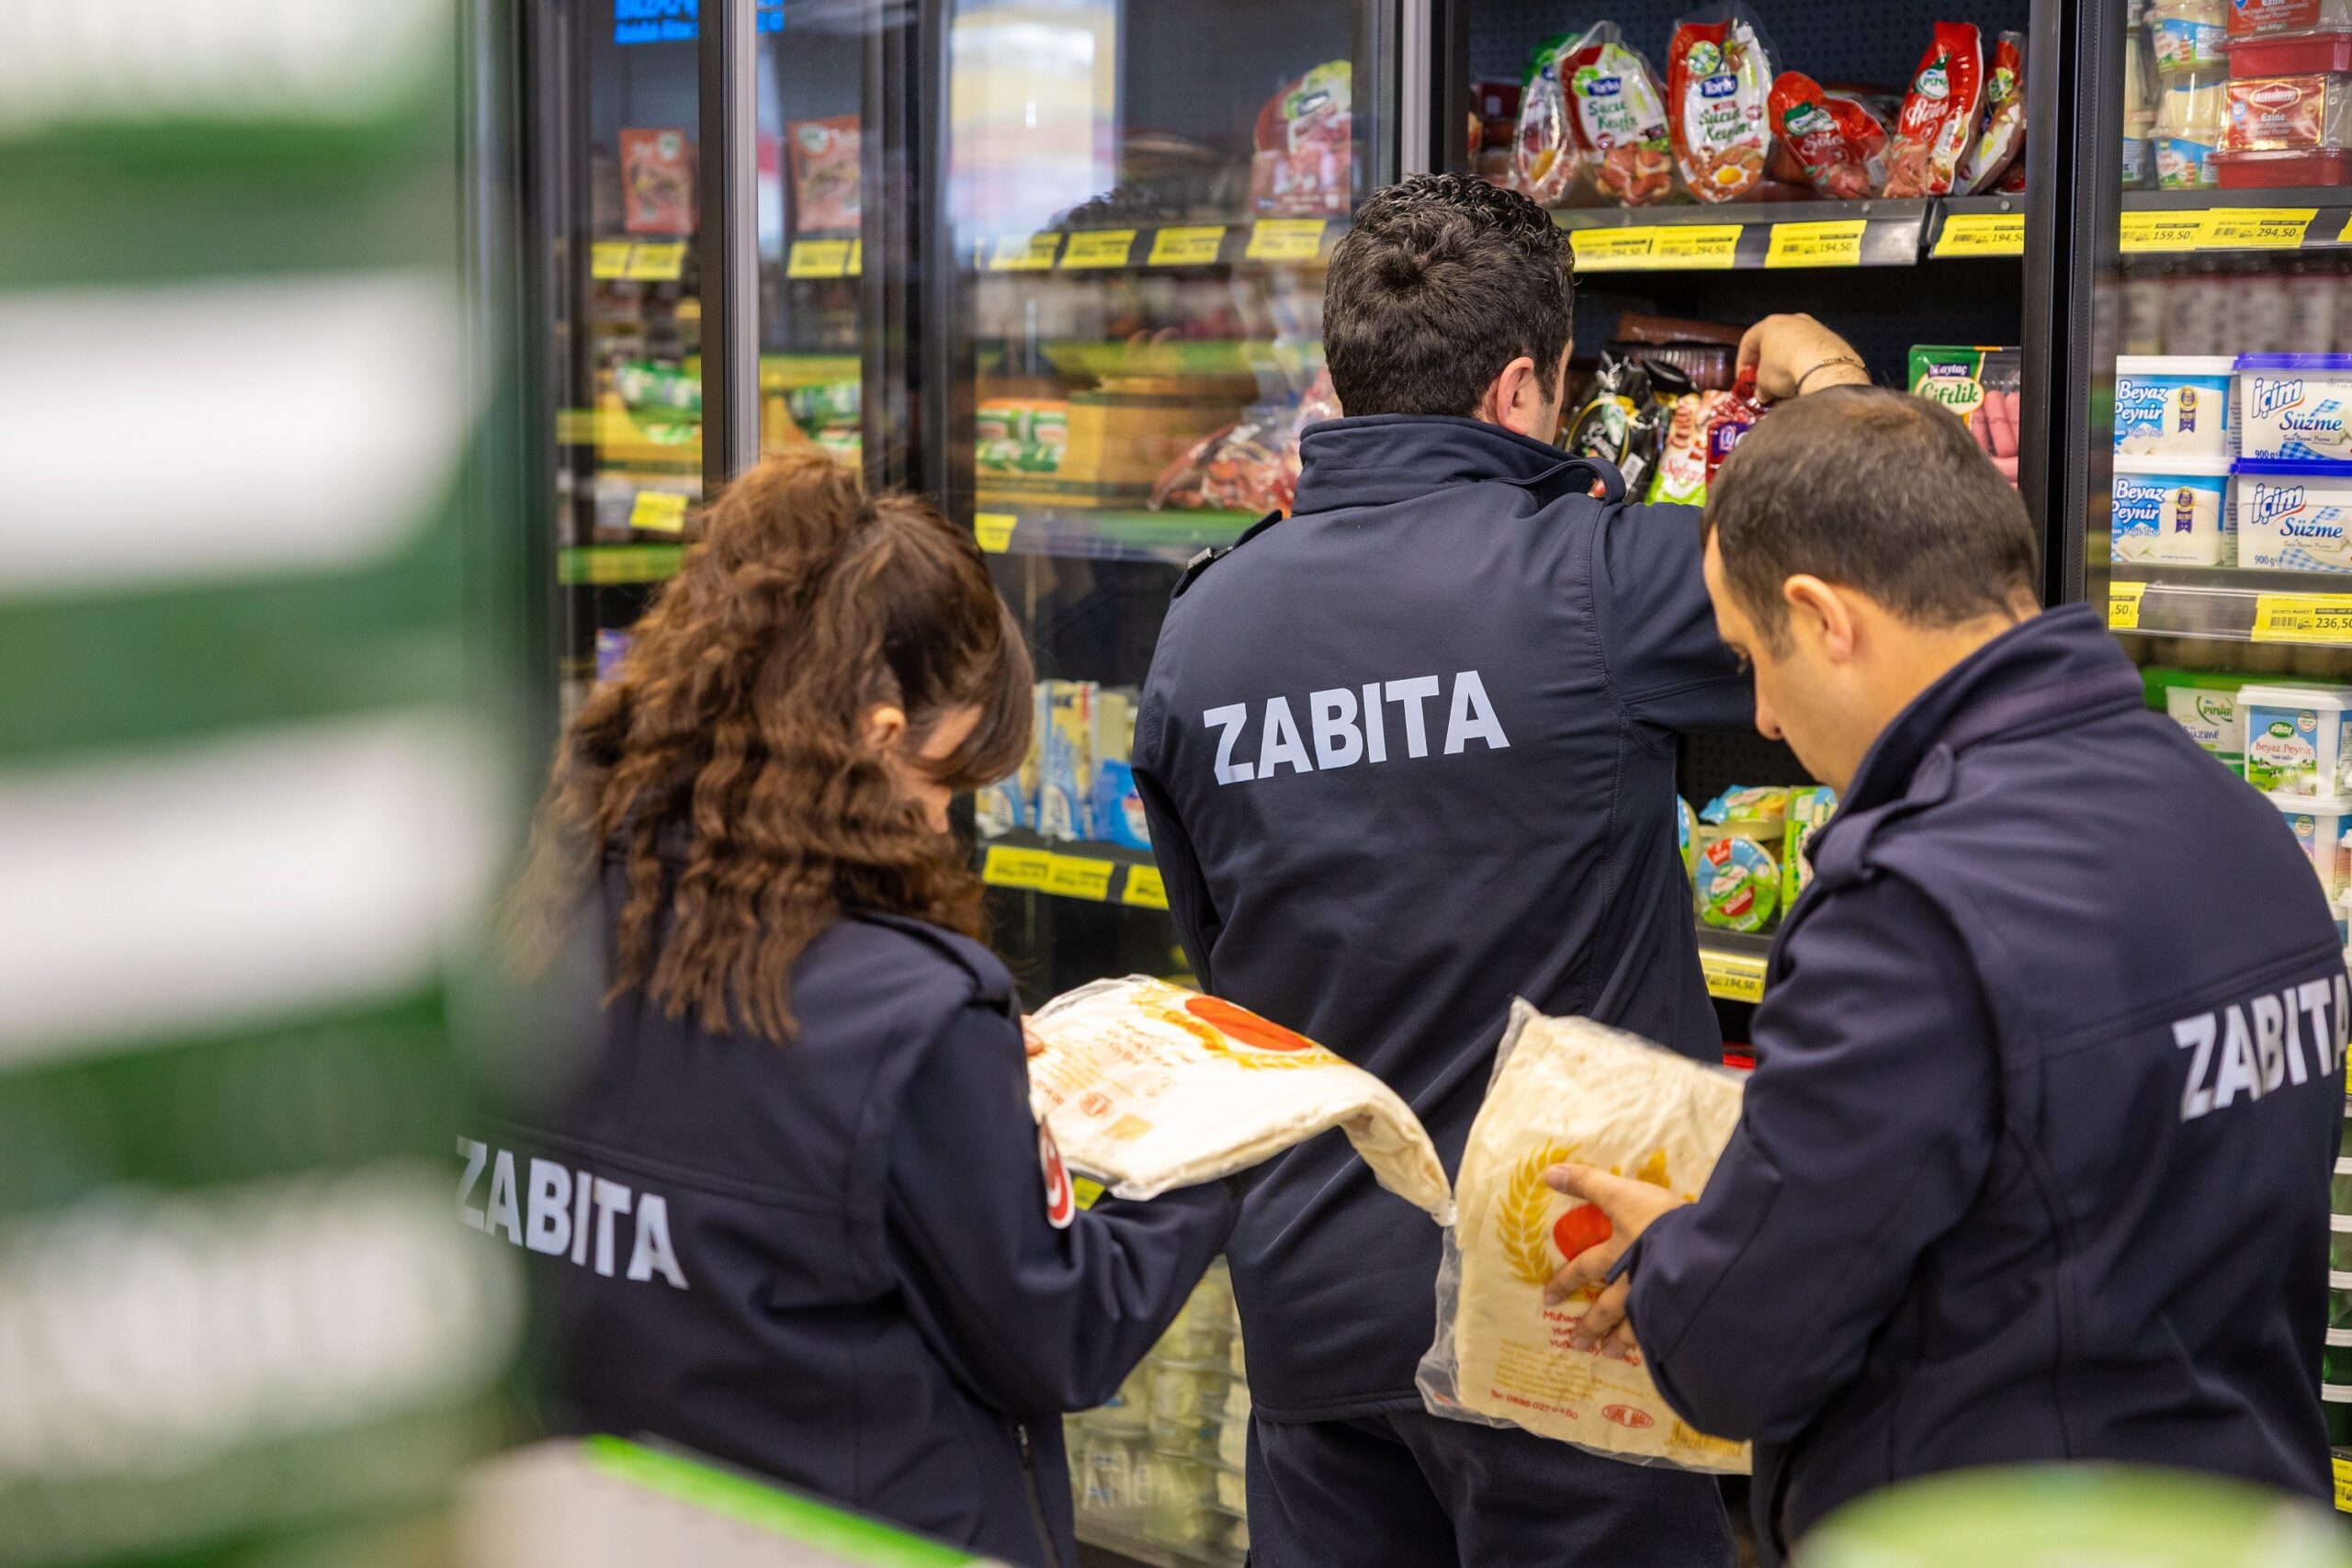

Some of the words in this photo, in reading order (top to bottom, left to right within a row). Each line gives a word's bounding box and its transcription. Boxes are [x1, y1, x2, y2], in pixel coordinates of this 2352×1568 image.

[2153, 231, 2191, 242] 159,50
[2256, 228, 2297, 239] 294,50
[1819, 242, 1852, 253] 194,50
[2118, 379, 2168, 404] Beyaz
[2252, 378, 2303, 419] İçim
[2279, 411, 2343, 431] Süzme
[2116, 479, 2165, 503] Beyaz
[2252, 482, 2304, 525] İçim
[2280, 517, 2344, 538] Süzme
[2255, 554, 2268, 565] 900
[2203, 705, 2233, 717] PINAR
[1203, 670, 1510, 785] ZABITA
[2256, 741, 2280, 753] Beyaz
[2283, 743, 2312, 755] Peynir
[1725, 974, 1756, 990] 194,50
[2171, 974, 2351, 1122] ZABITA
[456, 1135, 690, 1291] ZABITA
